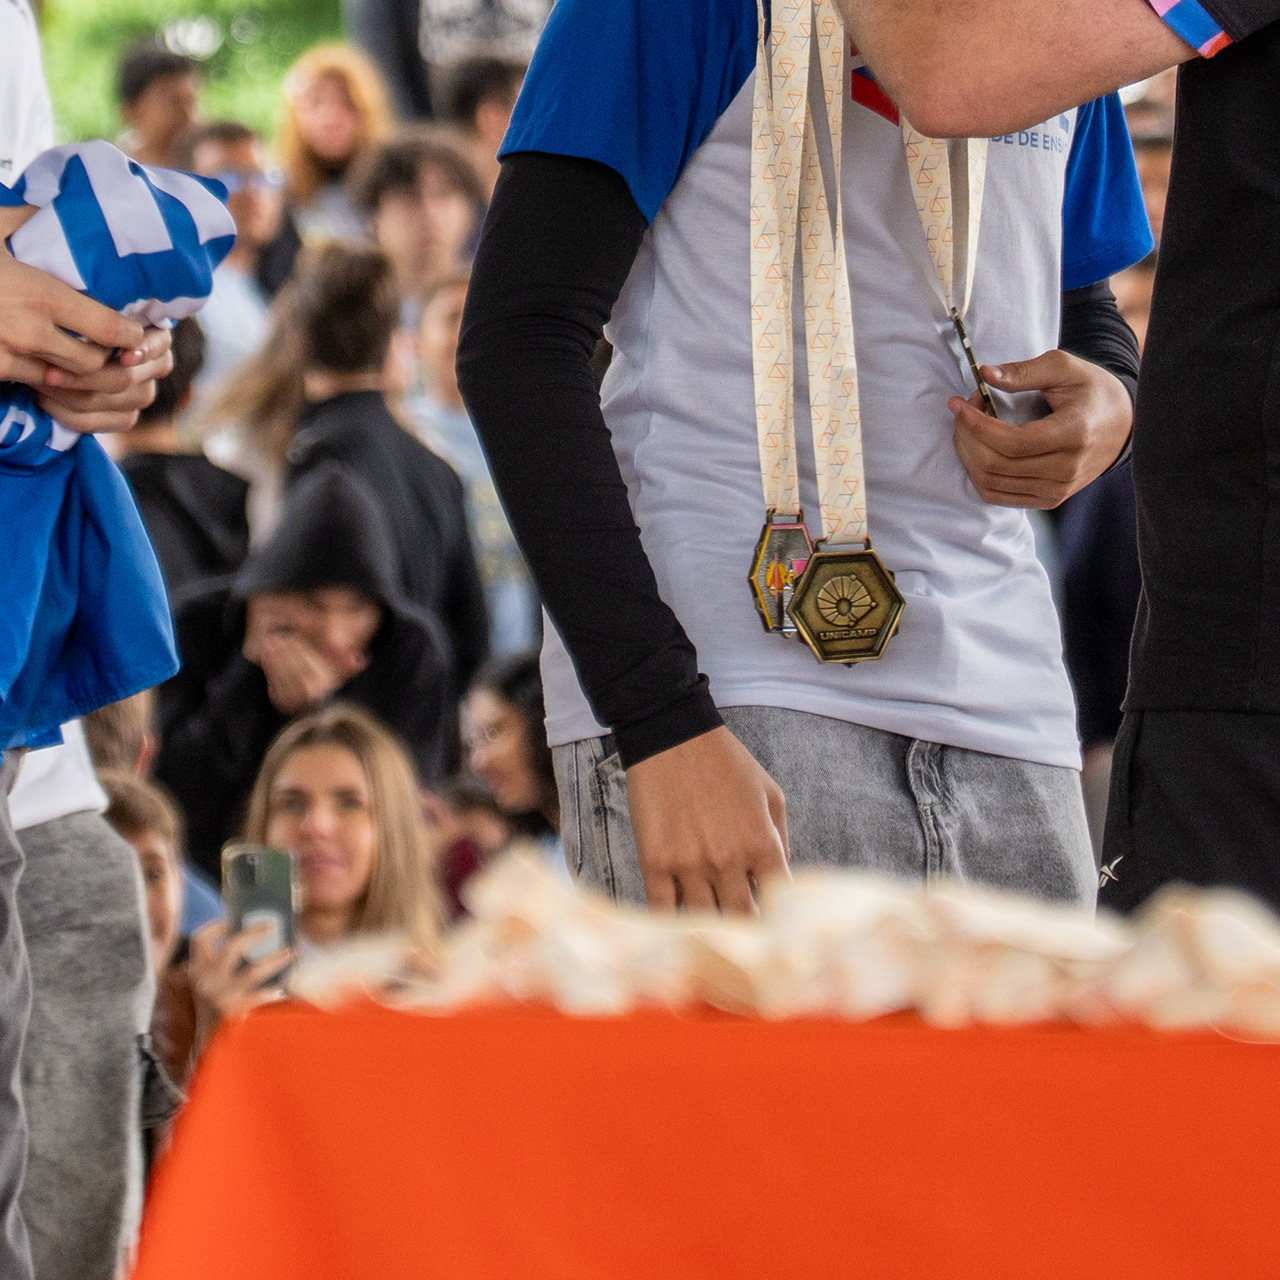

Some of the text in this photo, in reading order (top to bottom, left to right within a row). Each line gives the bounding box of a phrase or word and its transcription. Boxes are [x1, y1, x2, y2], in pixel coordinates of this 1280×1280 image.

[1018, 131, 1039, 148] DE
[1042, 134, 1064, 154] ENS
[820, 628, 877, 640] UNICAMP
